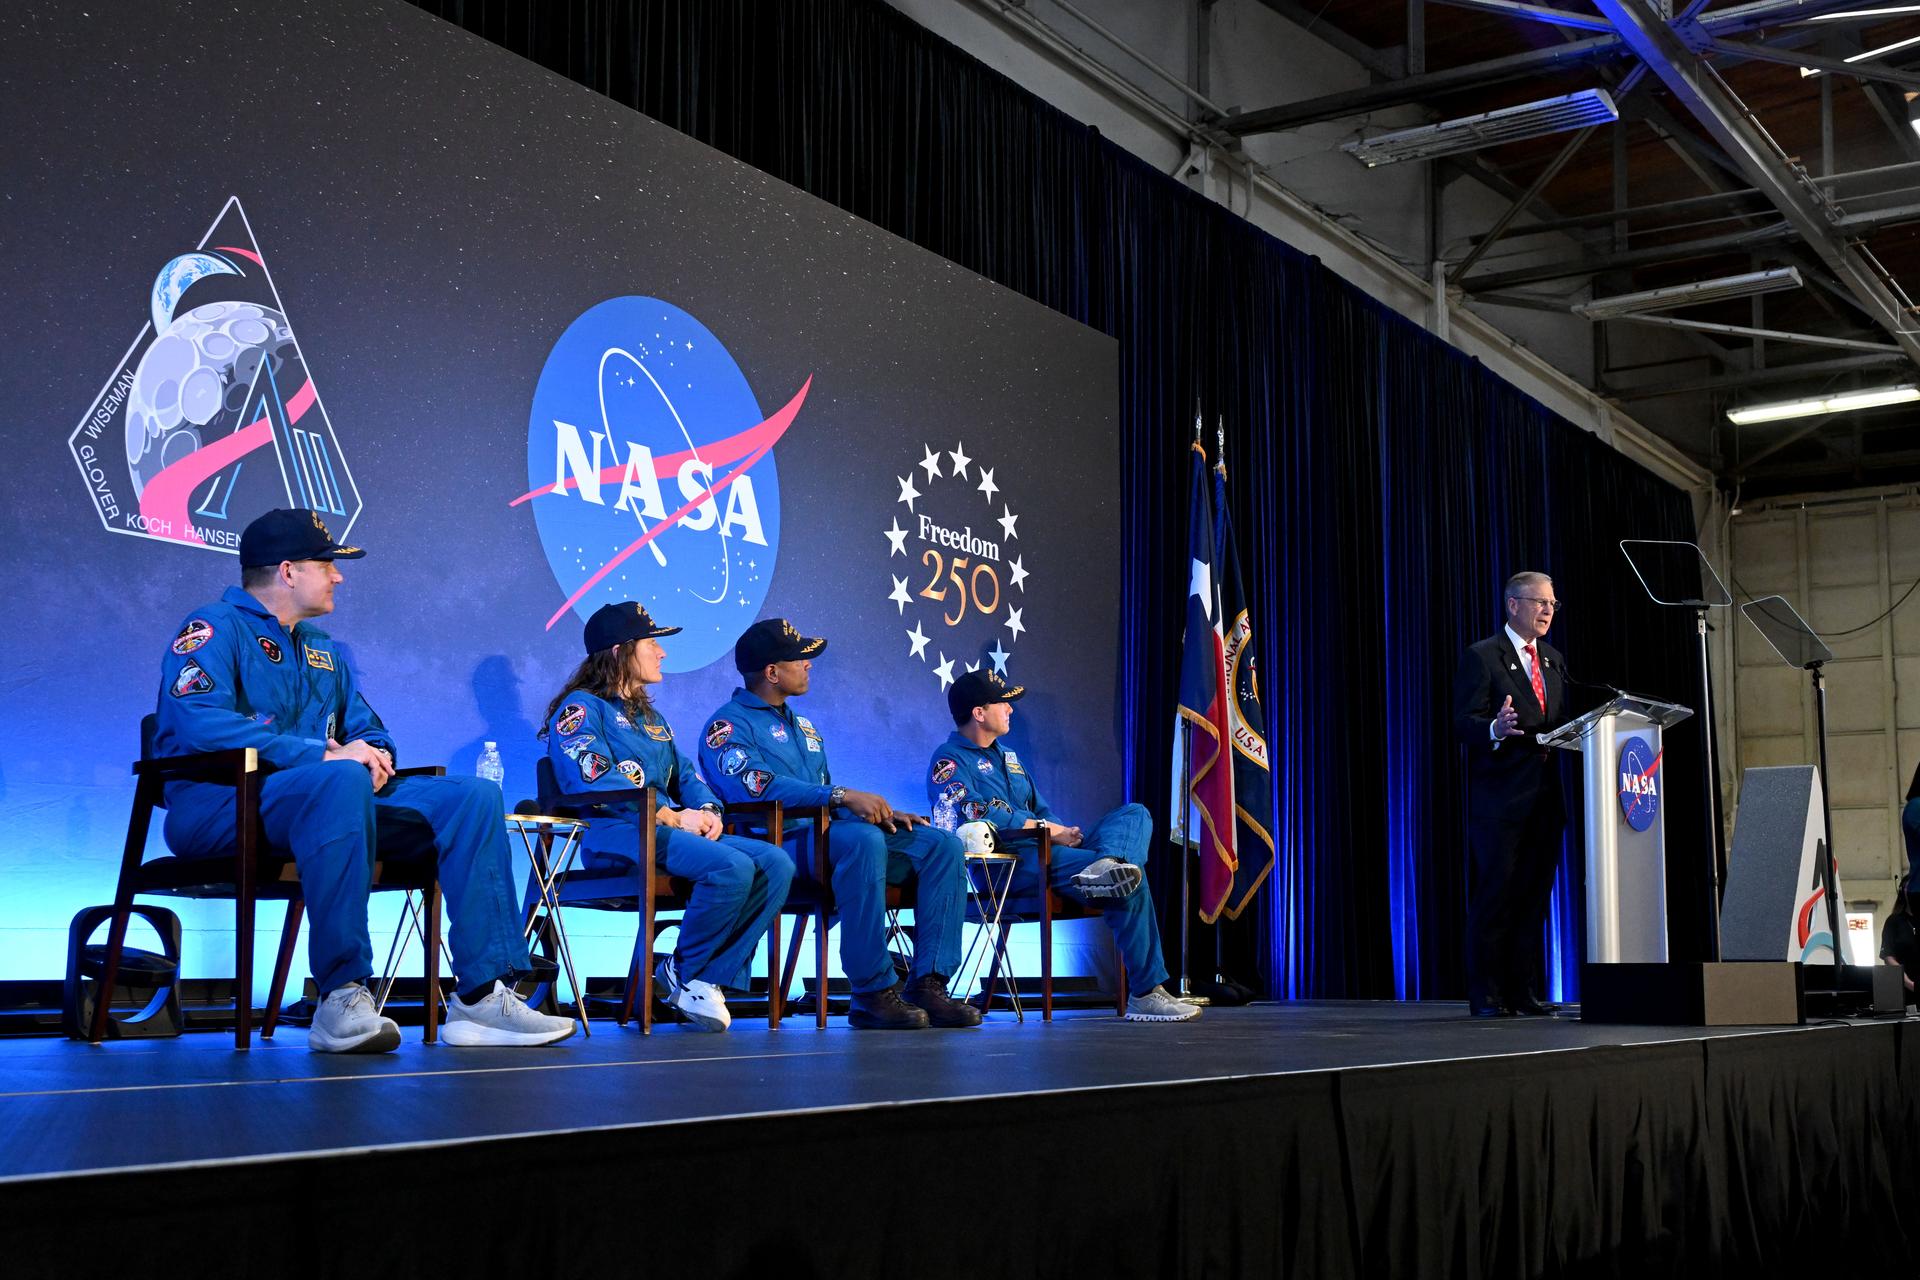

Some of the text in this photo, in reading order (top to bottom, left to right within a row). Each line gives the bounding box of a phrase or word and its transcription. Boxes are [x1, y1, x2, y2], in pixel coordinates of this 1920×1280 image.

[84, 369, 136, 440] WISEMAN
[80, 445, 119, 520] GLOVER
[550, 420, 768, 546] NASA
[126, 513, 172, 534] KOCH
[918, 513, 1000, 561] Freedom
[919, 549, 1000, 626] 250
[1234, 727, 1265, 759] U.S.A.
[1622, 772, 1657, 796] NASA
